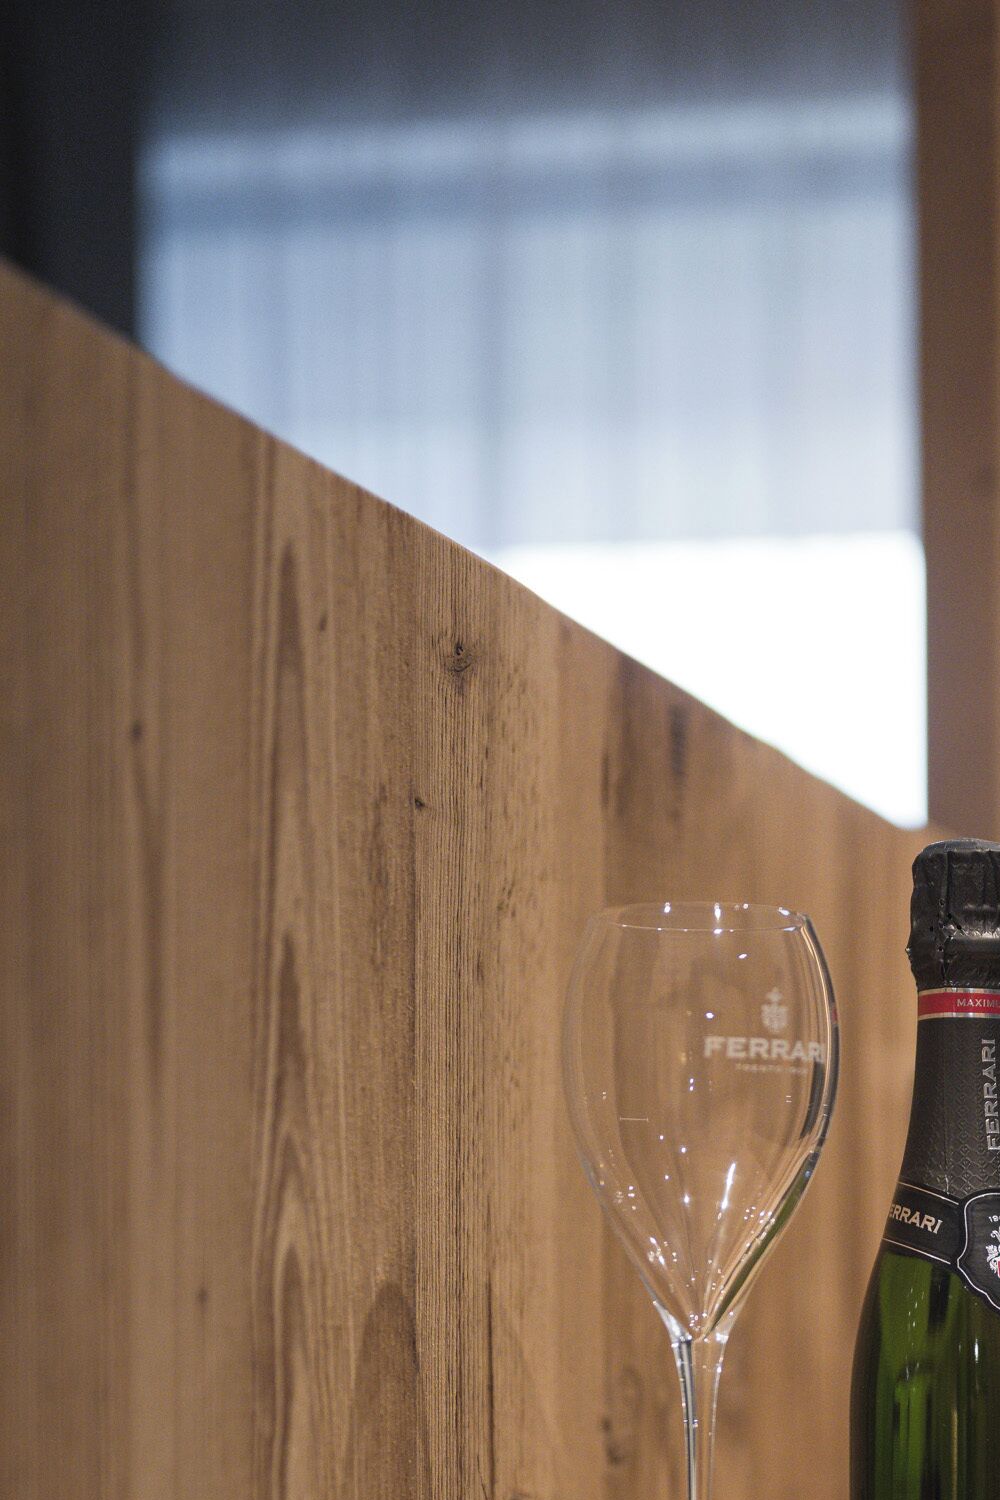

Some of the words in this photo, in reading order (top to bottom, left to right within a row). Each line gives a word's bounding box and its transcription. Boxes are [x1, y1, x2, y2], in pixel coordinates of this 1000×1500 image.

[703, 1035, 825, 1063] FERRARI
[981, 1038, 1000, 1151] FERRARI
[888, 1204, 944, 1234] ERRARI
